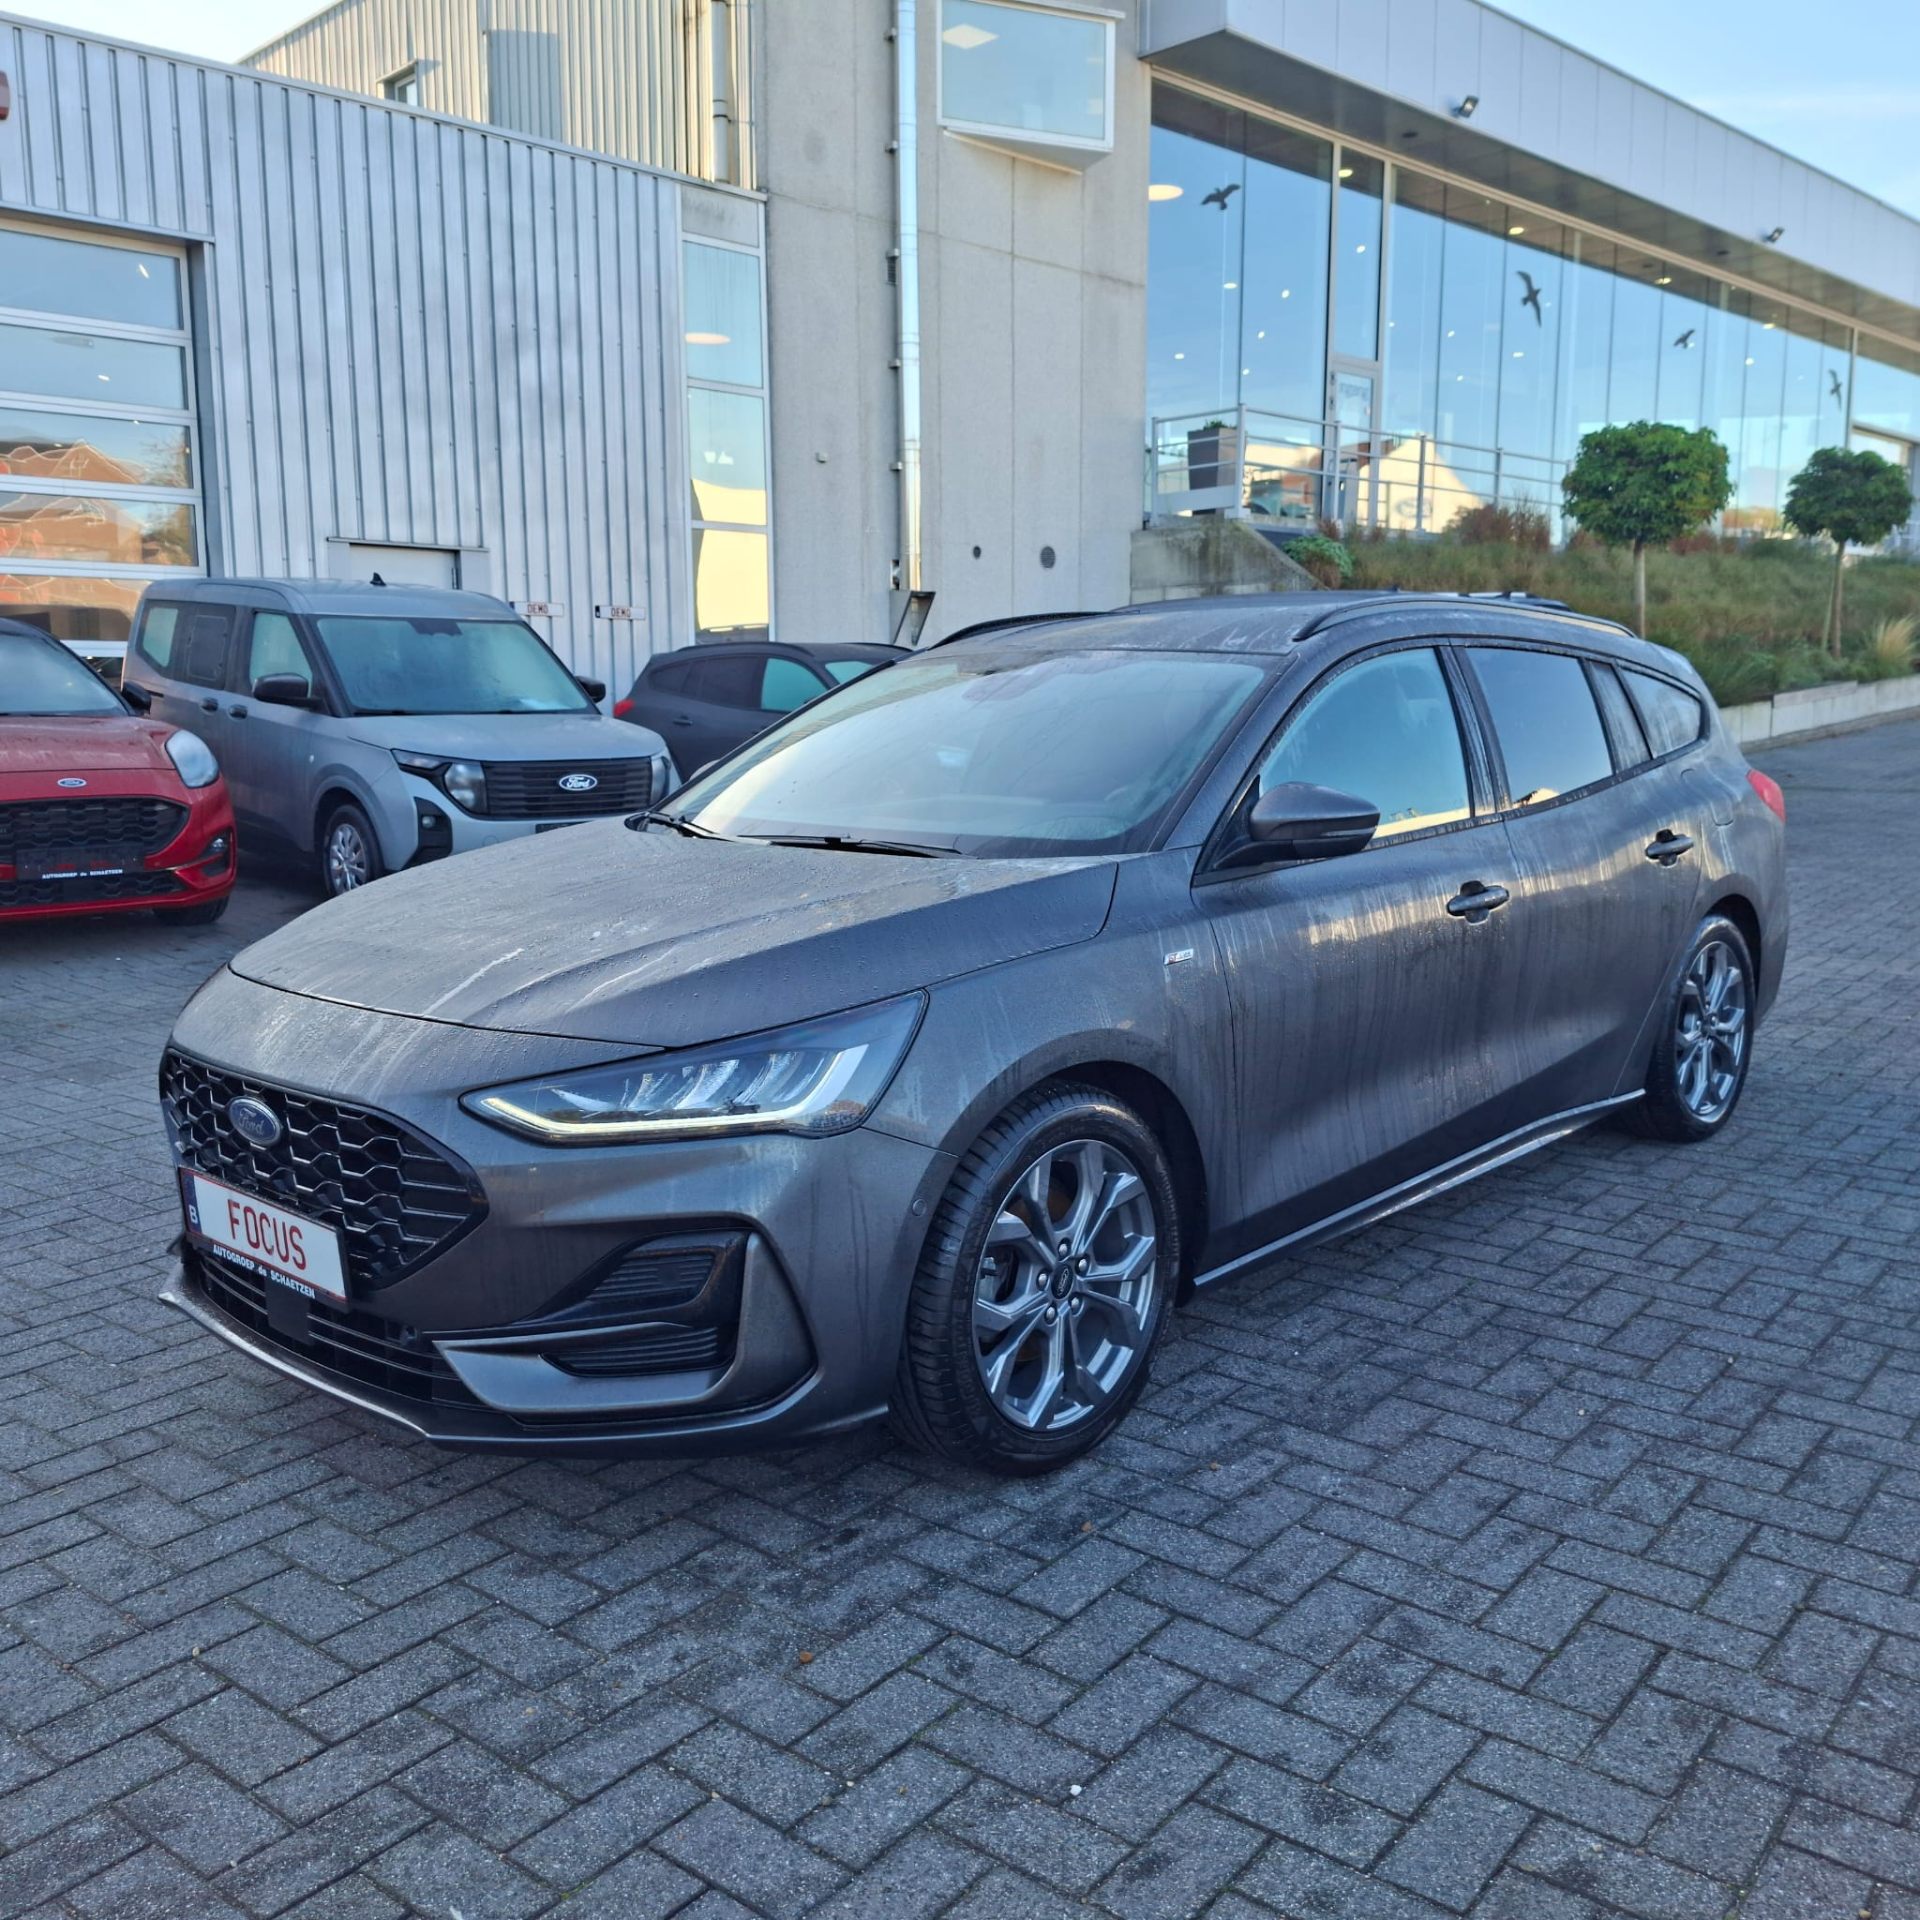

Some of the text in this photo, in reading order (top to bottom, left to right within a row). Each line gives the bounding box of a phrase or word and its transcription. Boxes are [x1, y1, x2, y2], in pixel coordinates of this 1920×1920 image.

[528, 604, 548, 614] DEMO
[611, 608, 631, 618] DEMO
[239, 1107, 265, 1136] Ford
[189, 1204, 198, 1224] B
[228, 1199, 306, 1270] FOCUS
[213, 1244, 315, 1299] AUTOGROEP de SCHAETZEN
